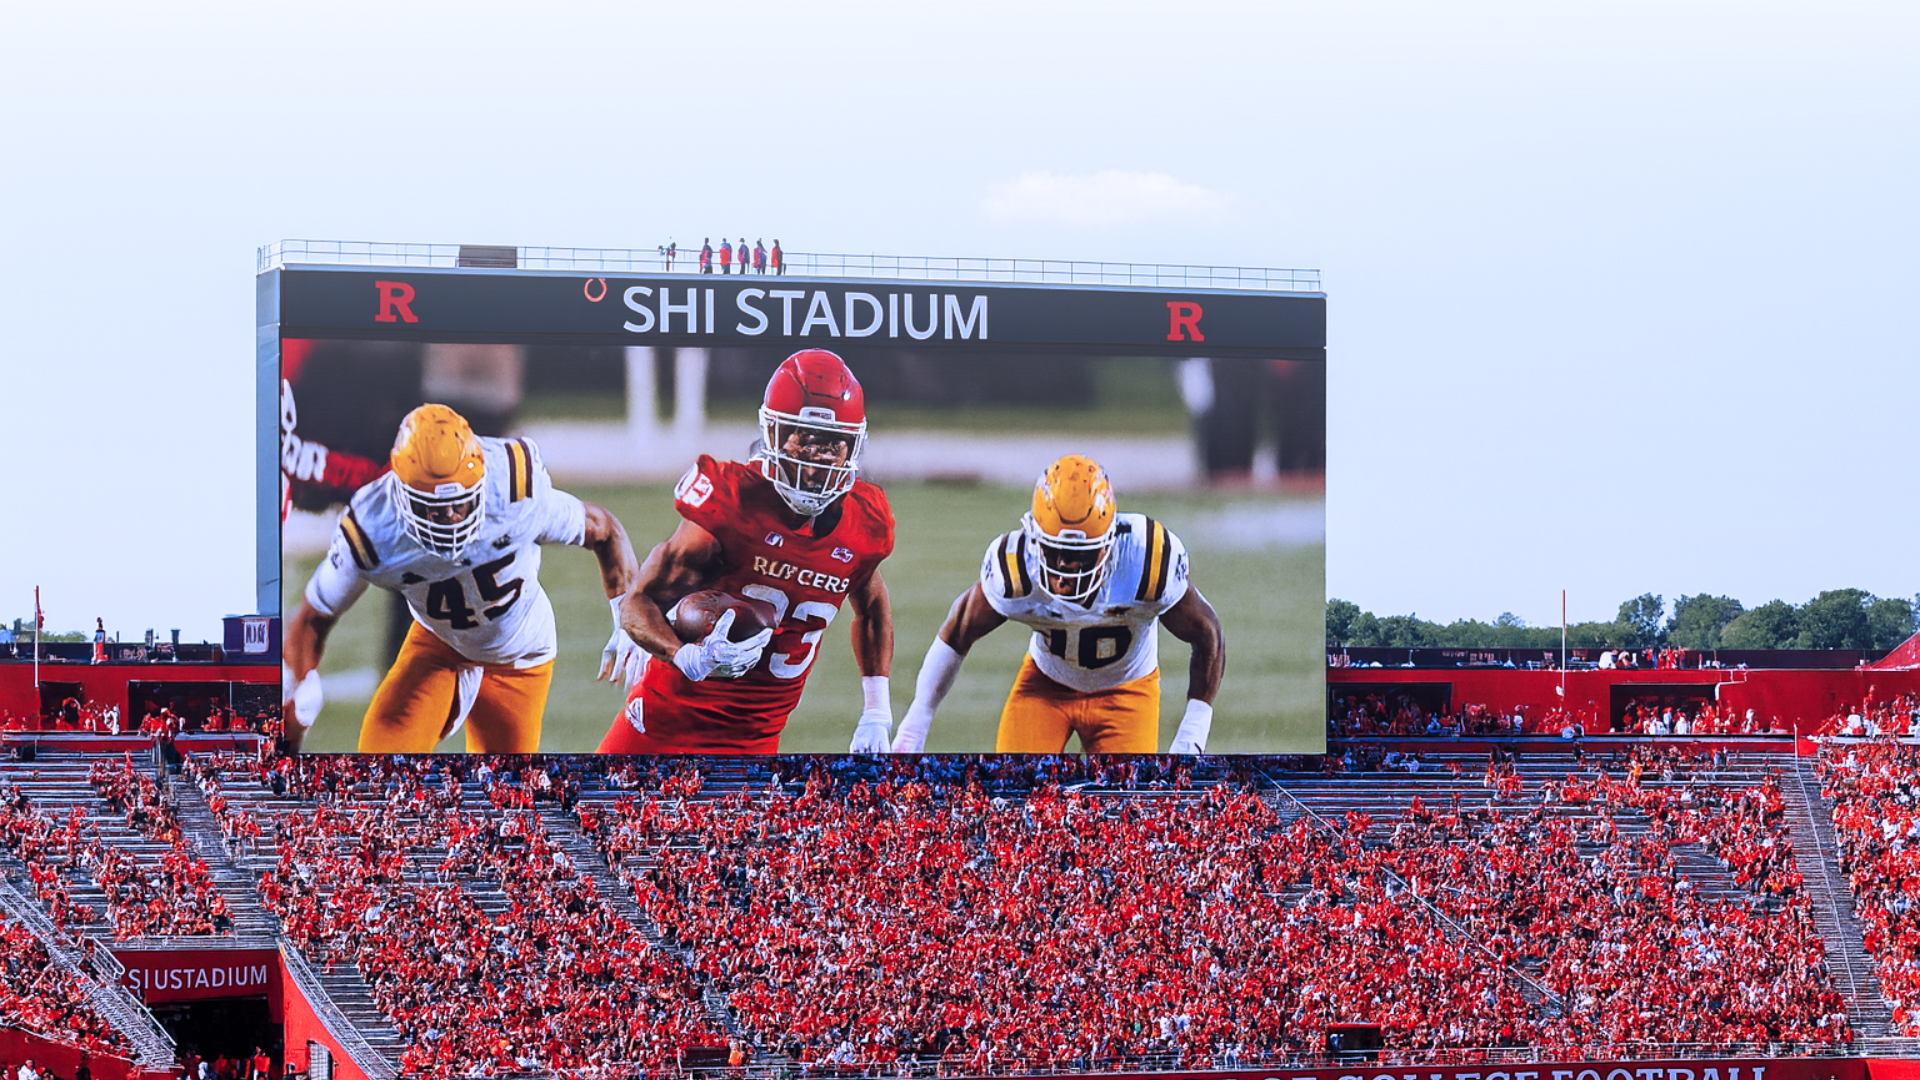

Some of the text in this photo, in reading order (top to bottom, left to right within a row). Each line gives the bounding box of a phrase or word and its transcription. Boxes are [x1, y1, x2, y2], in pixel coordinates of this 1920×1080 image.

[375, 280, 419, 324] R
[623, 285, 988, 340] SHI STADIUM
[1166, 302, 1205, 342] R
[427, 554, 524, 630] 45
